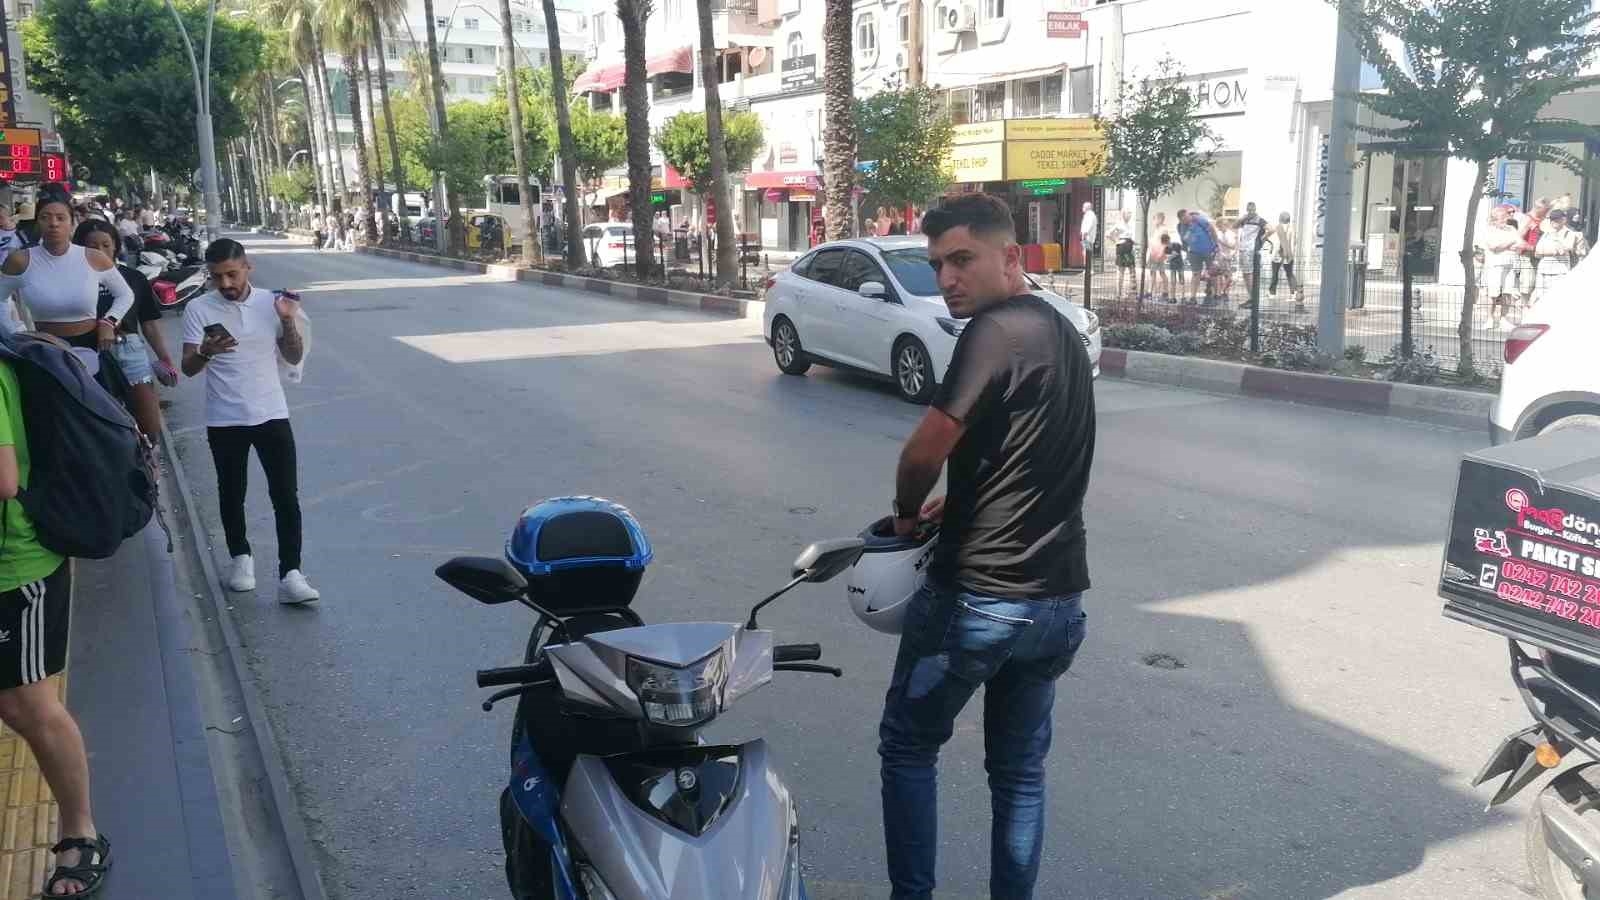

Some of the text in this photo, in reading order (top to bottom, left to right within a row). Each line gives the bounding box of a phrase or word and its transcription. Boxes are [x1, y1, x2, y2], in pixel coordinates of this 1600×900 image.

[1048, 21, 1080, 30] EMLAK
[1198, 80, 1248, 106] HOM
[1562, 513, 1600, 537] dön
[1521, 539, 1580, 571] PAKET
[1549, 573, 1582, 599] 742
